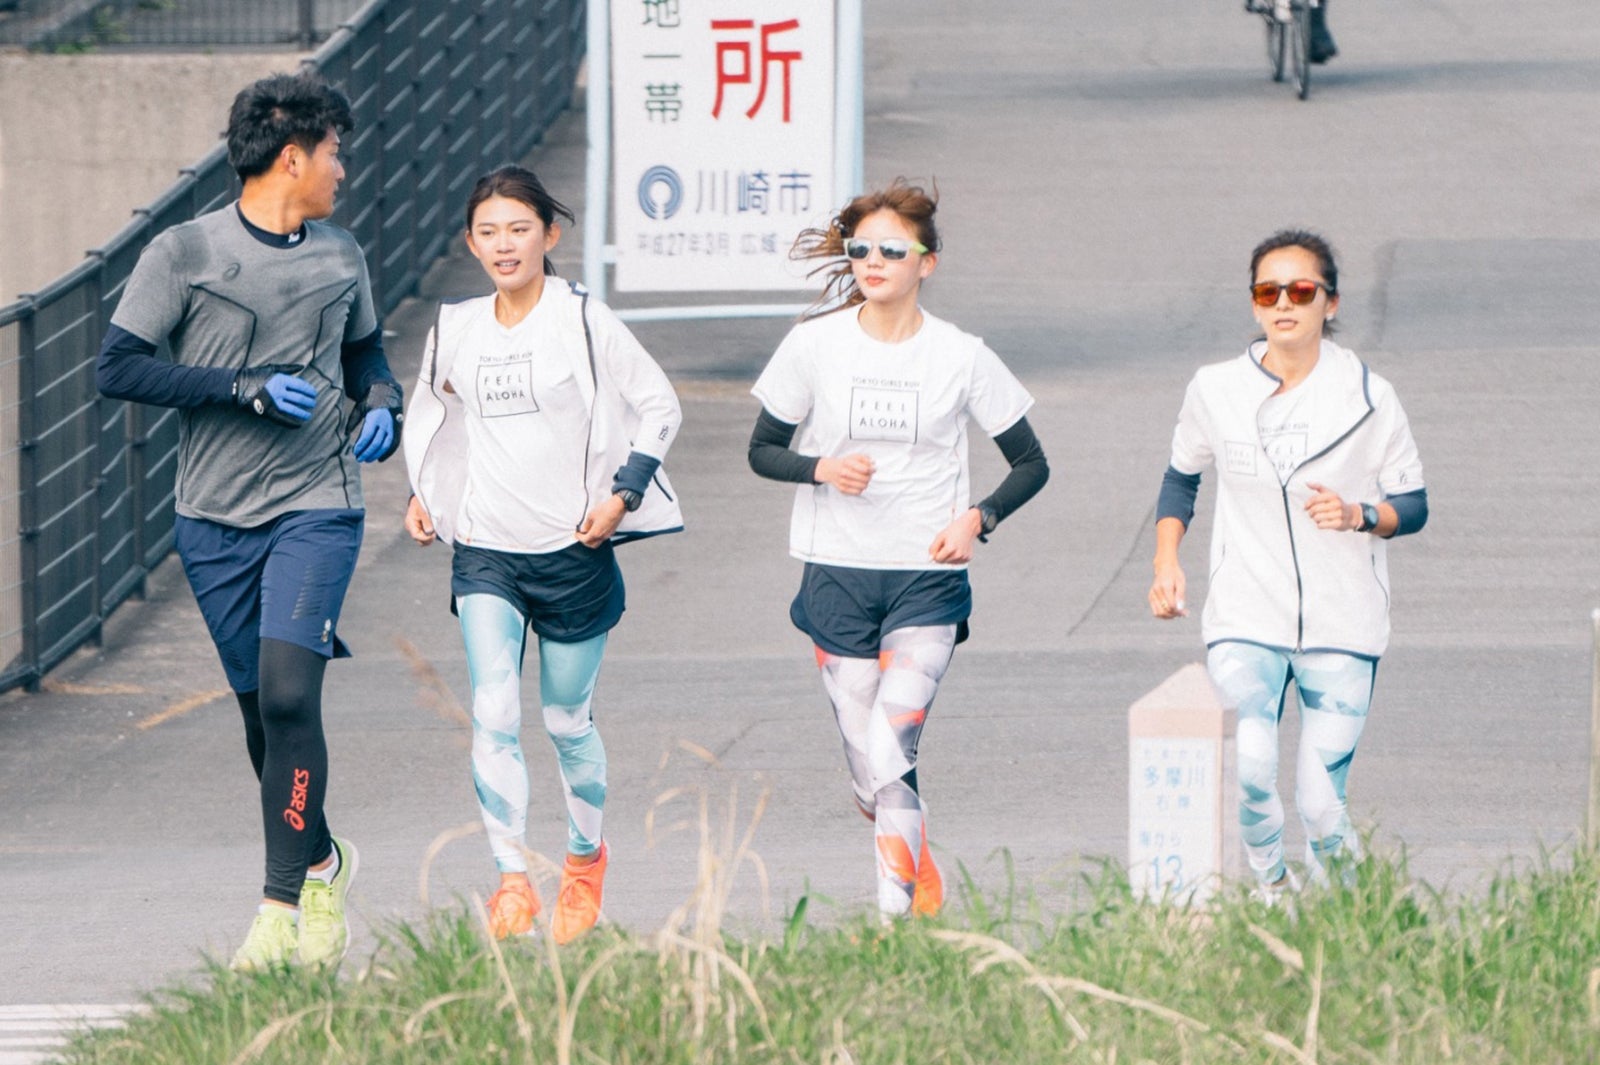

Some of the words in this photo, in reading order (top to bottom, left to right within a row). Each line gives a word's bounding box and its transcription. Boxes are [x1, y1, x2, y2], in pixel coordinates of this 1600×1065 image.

[710, 18, 803, 123] 所
[696, 169, 813, 216] 川崎市
[486, 389, 526, 402] ALOHA
[859, 417, 908, 429] ALOHA
[1150, 854, 1184, 892] 13
